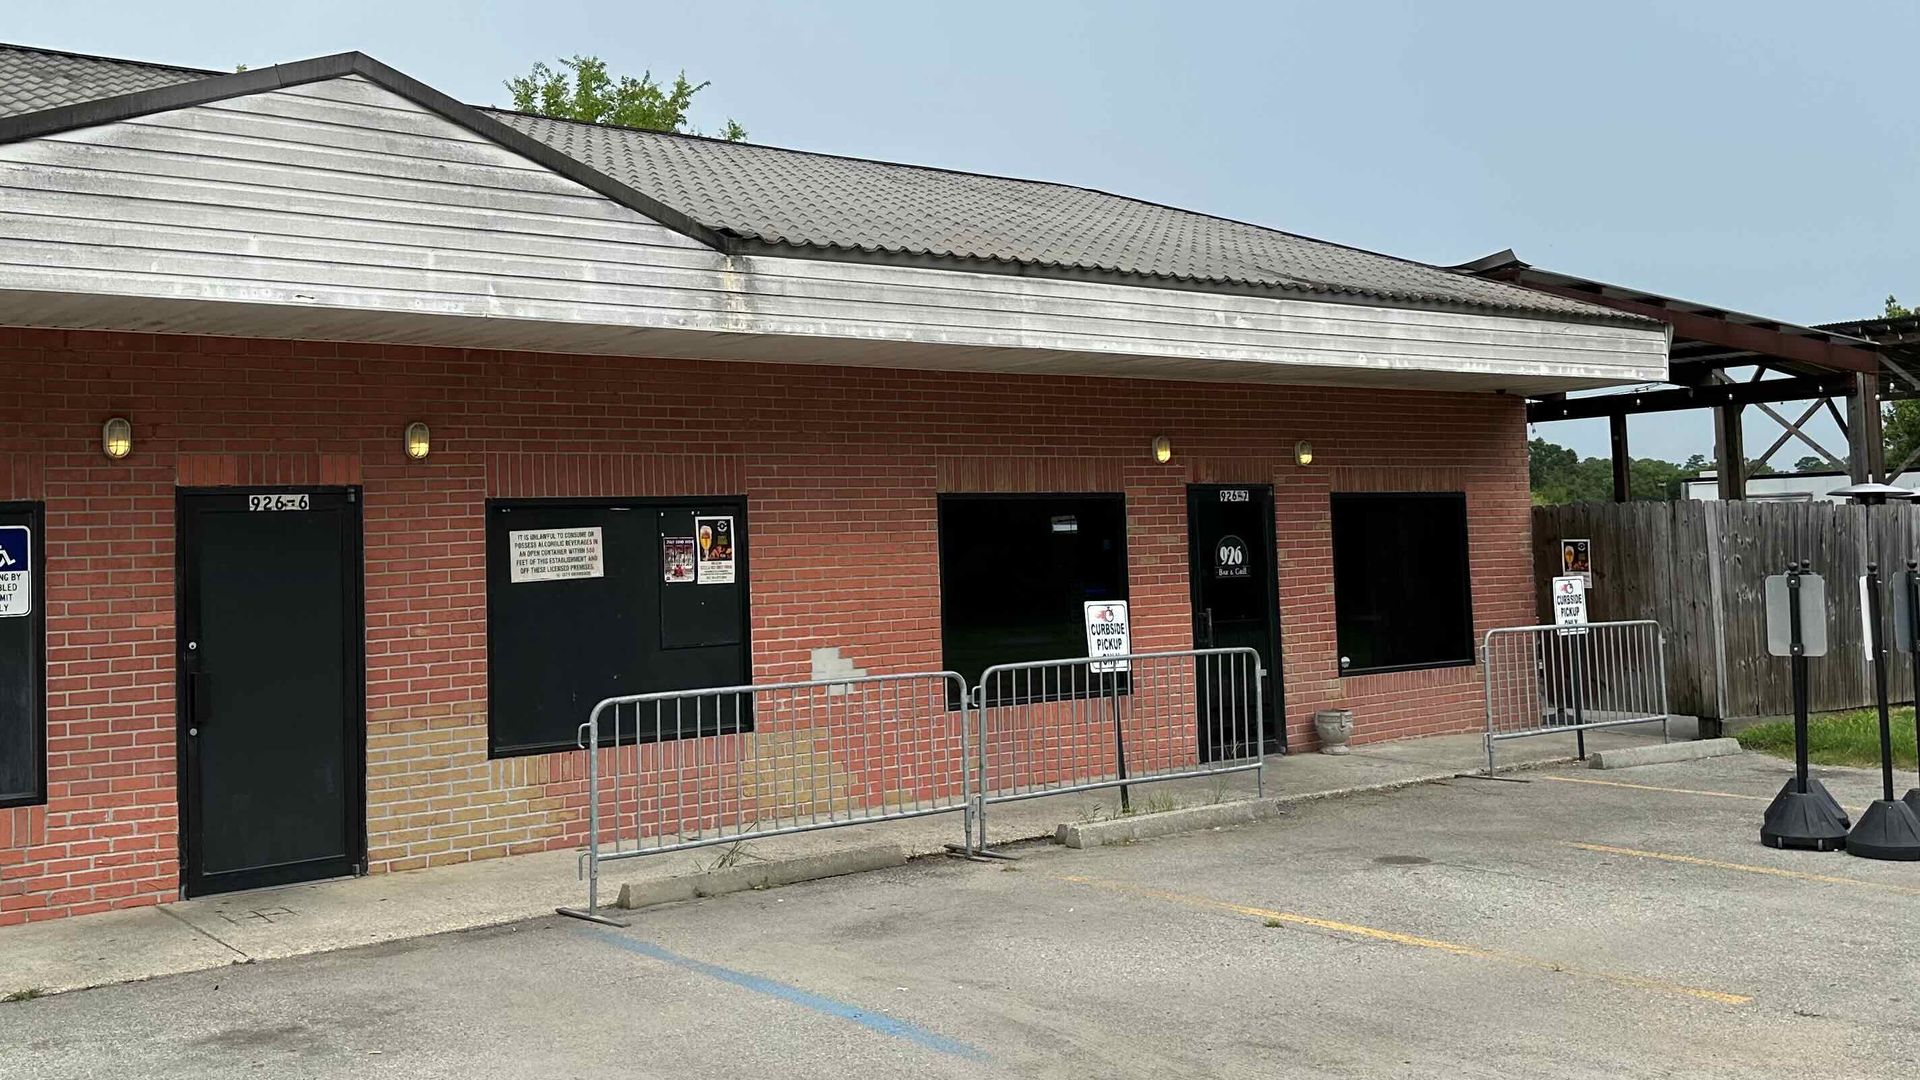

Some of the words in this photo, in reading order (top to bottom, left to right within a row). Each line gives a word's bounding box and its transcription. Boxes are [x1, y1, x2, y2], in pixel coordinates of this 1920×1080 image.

[250, 495, 308, 511] 926-6
[1220, 546, 1242, 565] 926
[1557, 594, 1582, 605] CURBSIDE
[1561, 606, 1580, 617] PICKUP
[1091, 623, 1125, 635] CURBSIDE
[1097, 638, 1122, 650] PICKUP
